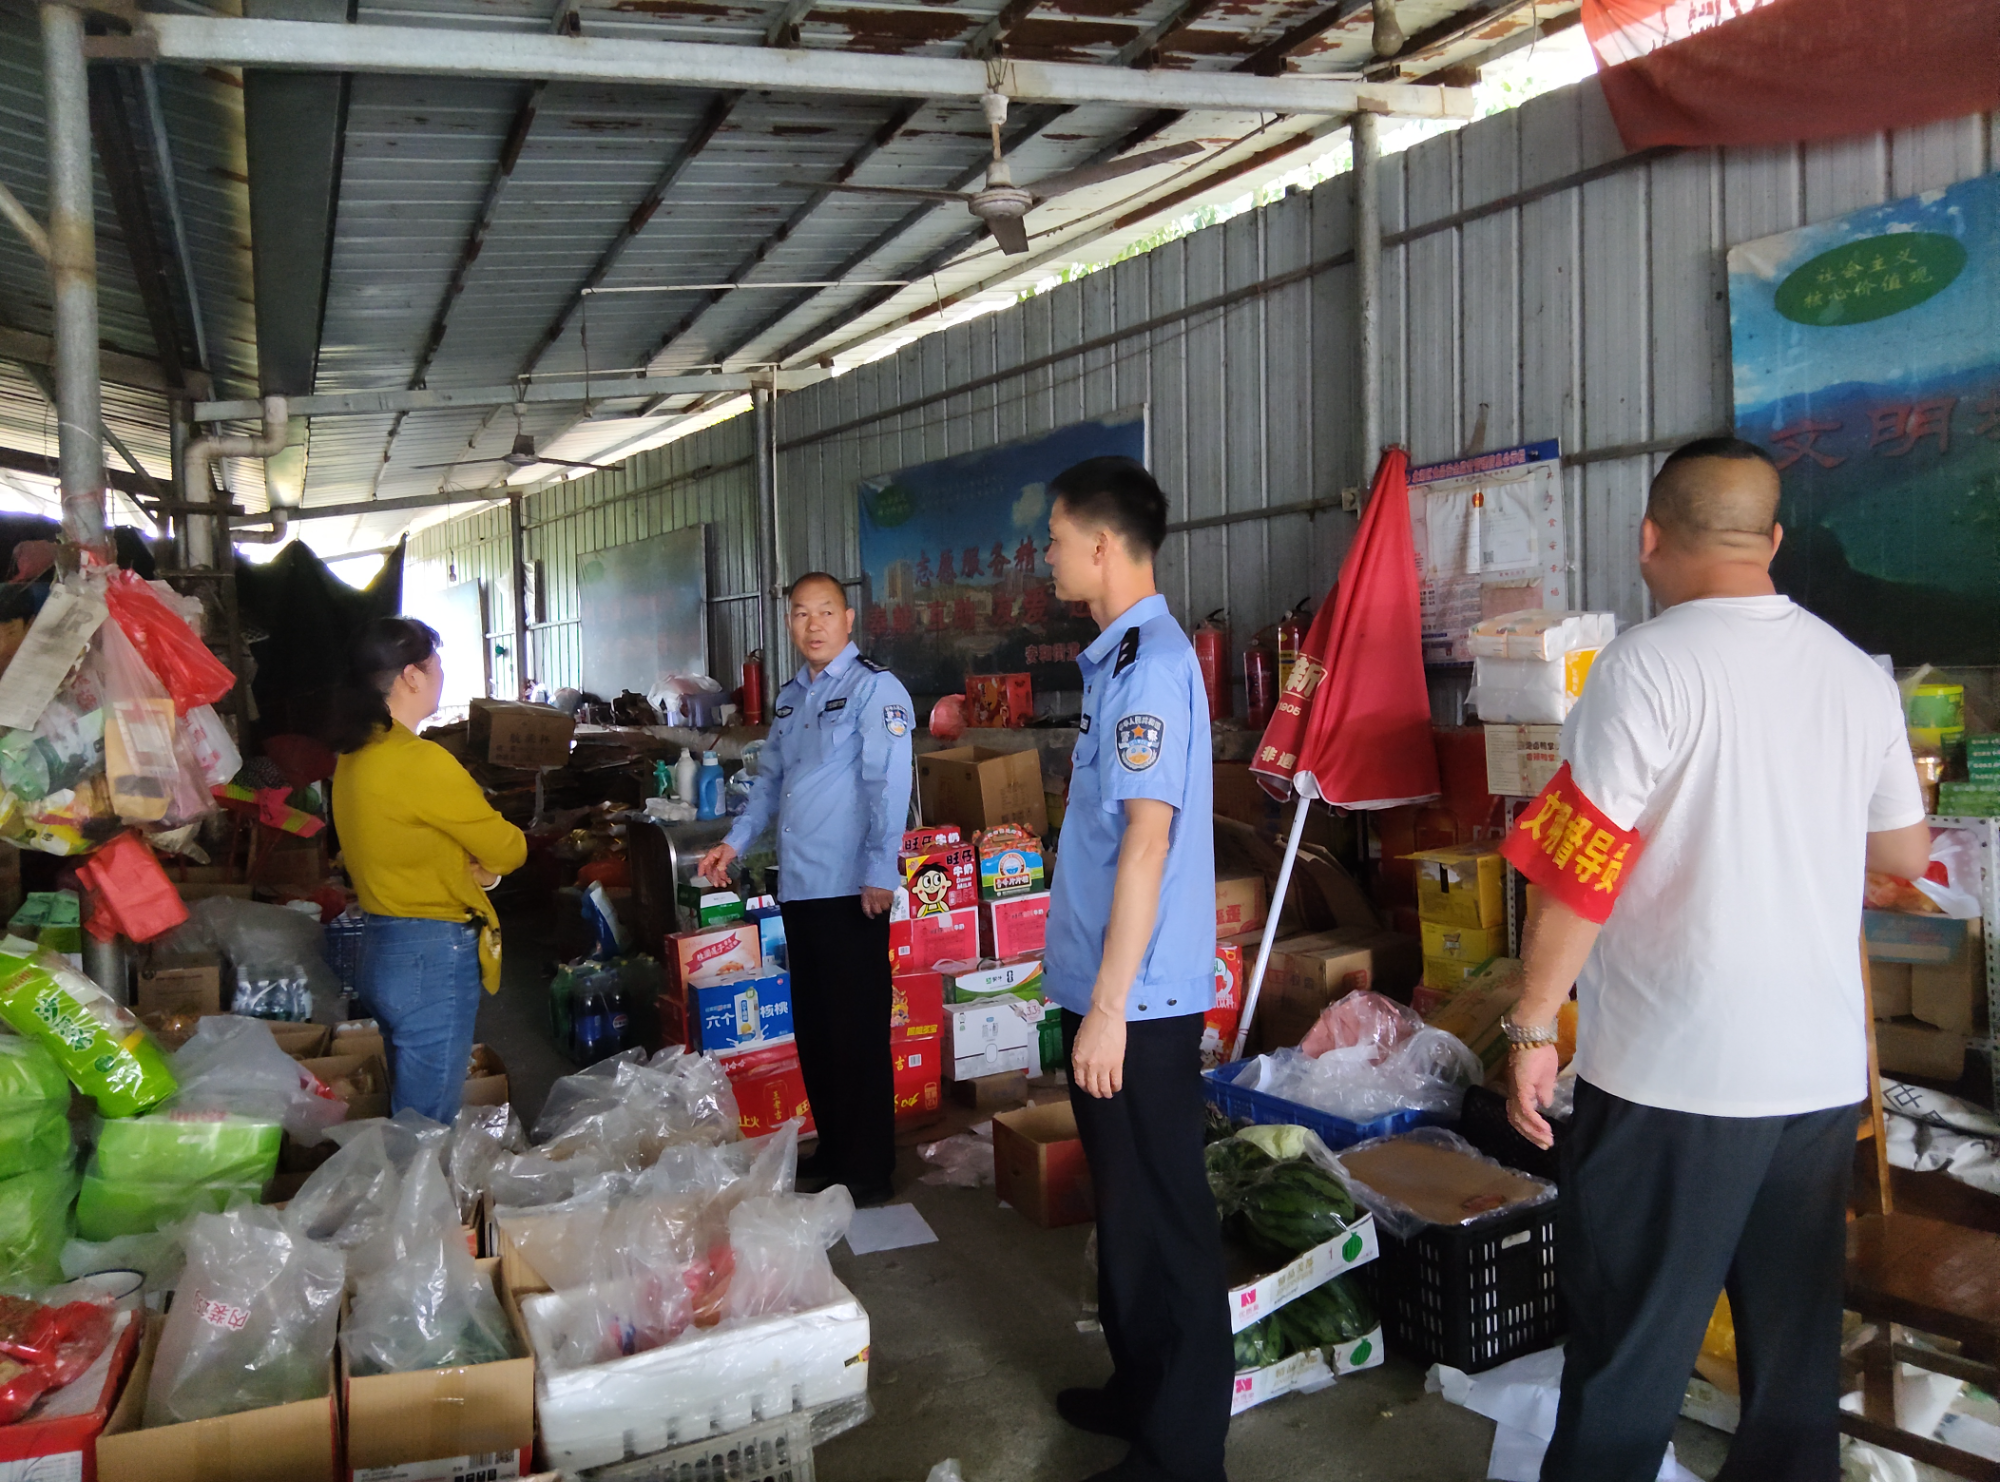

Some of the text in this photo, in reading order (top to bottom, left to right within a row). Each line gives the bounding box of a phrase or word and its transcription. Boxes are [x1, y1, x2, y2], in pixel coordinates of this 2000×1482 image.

[1816, 248, 1918, 284] 社会主义
[915, 535, 1052, 588] 志愿服务精
[1285, 656, 1322, 697] 新
[1277, 701, 1302, 717] 1905
[946, 848, 974, 866] 旺仔
[952, 862, 974, 878] 牛奶
[706, 1012, 735, 1029] 六个
[759, 1001, 789, 1019] 核桃
